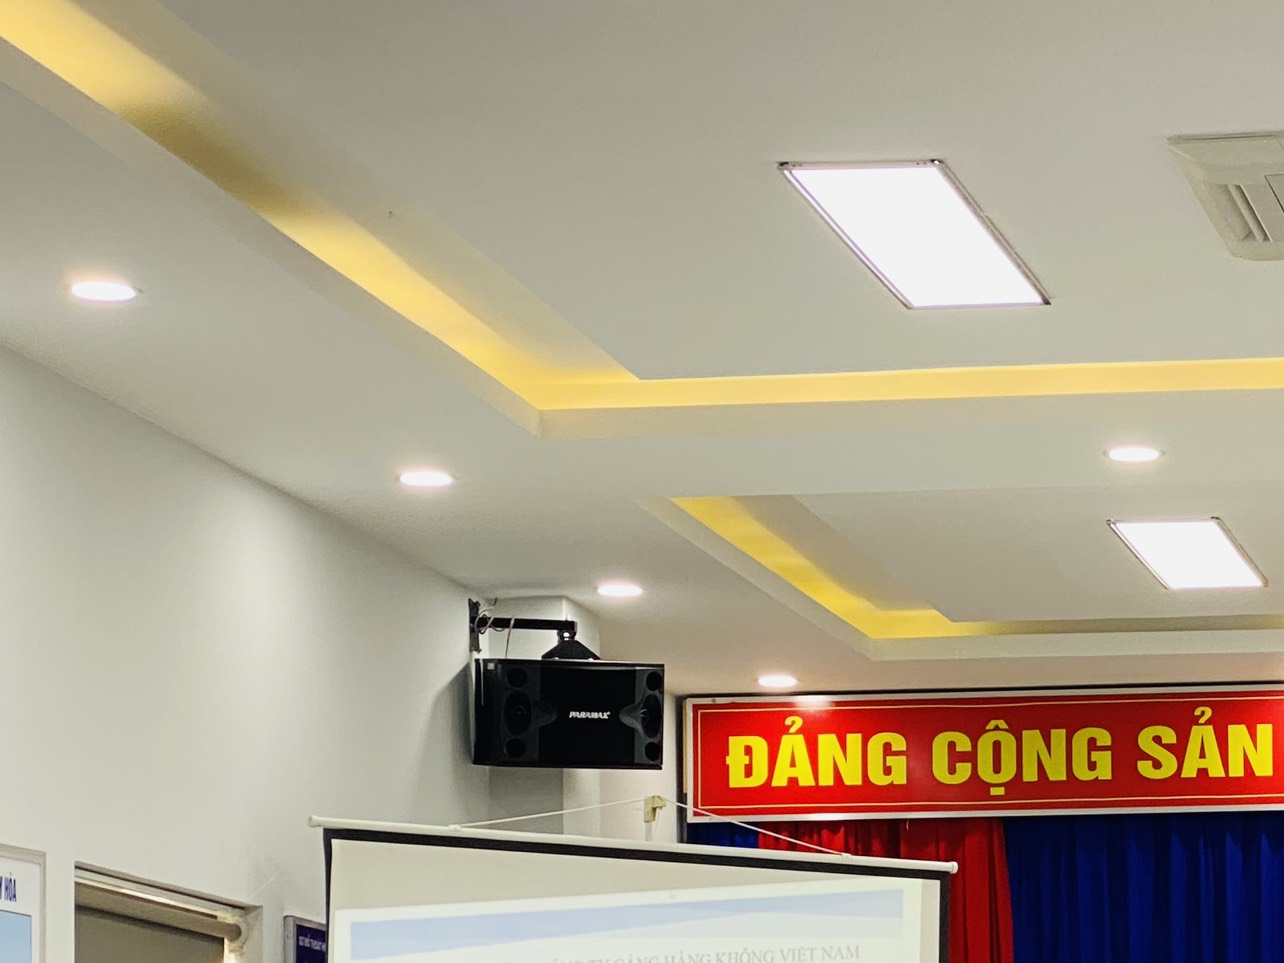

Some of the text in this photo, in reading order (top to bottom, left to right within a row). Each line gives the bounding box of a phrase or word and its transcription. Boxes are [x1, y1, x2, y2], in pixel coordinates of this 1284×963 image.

[727, 716, 907, 788] ĐẢNG
[933, 719, 1112, 795] CỘNG
[1138, 708, 1273, 779] SẢN
[821, 945, 861, 961] NAM
